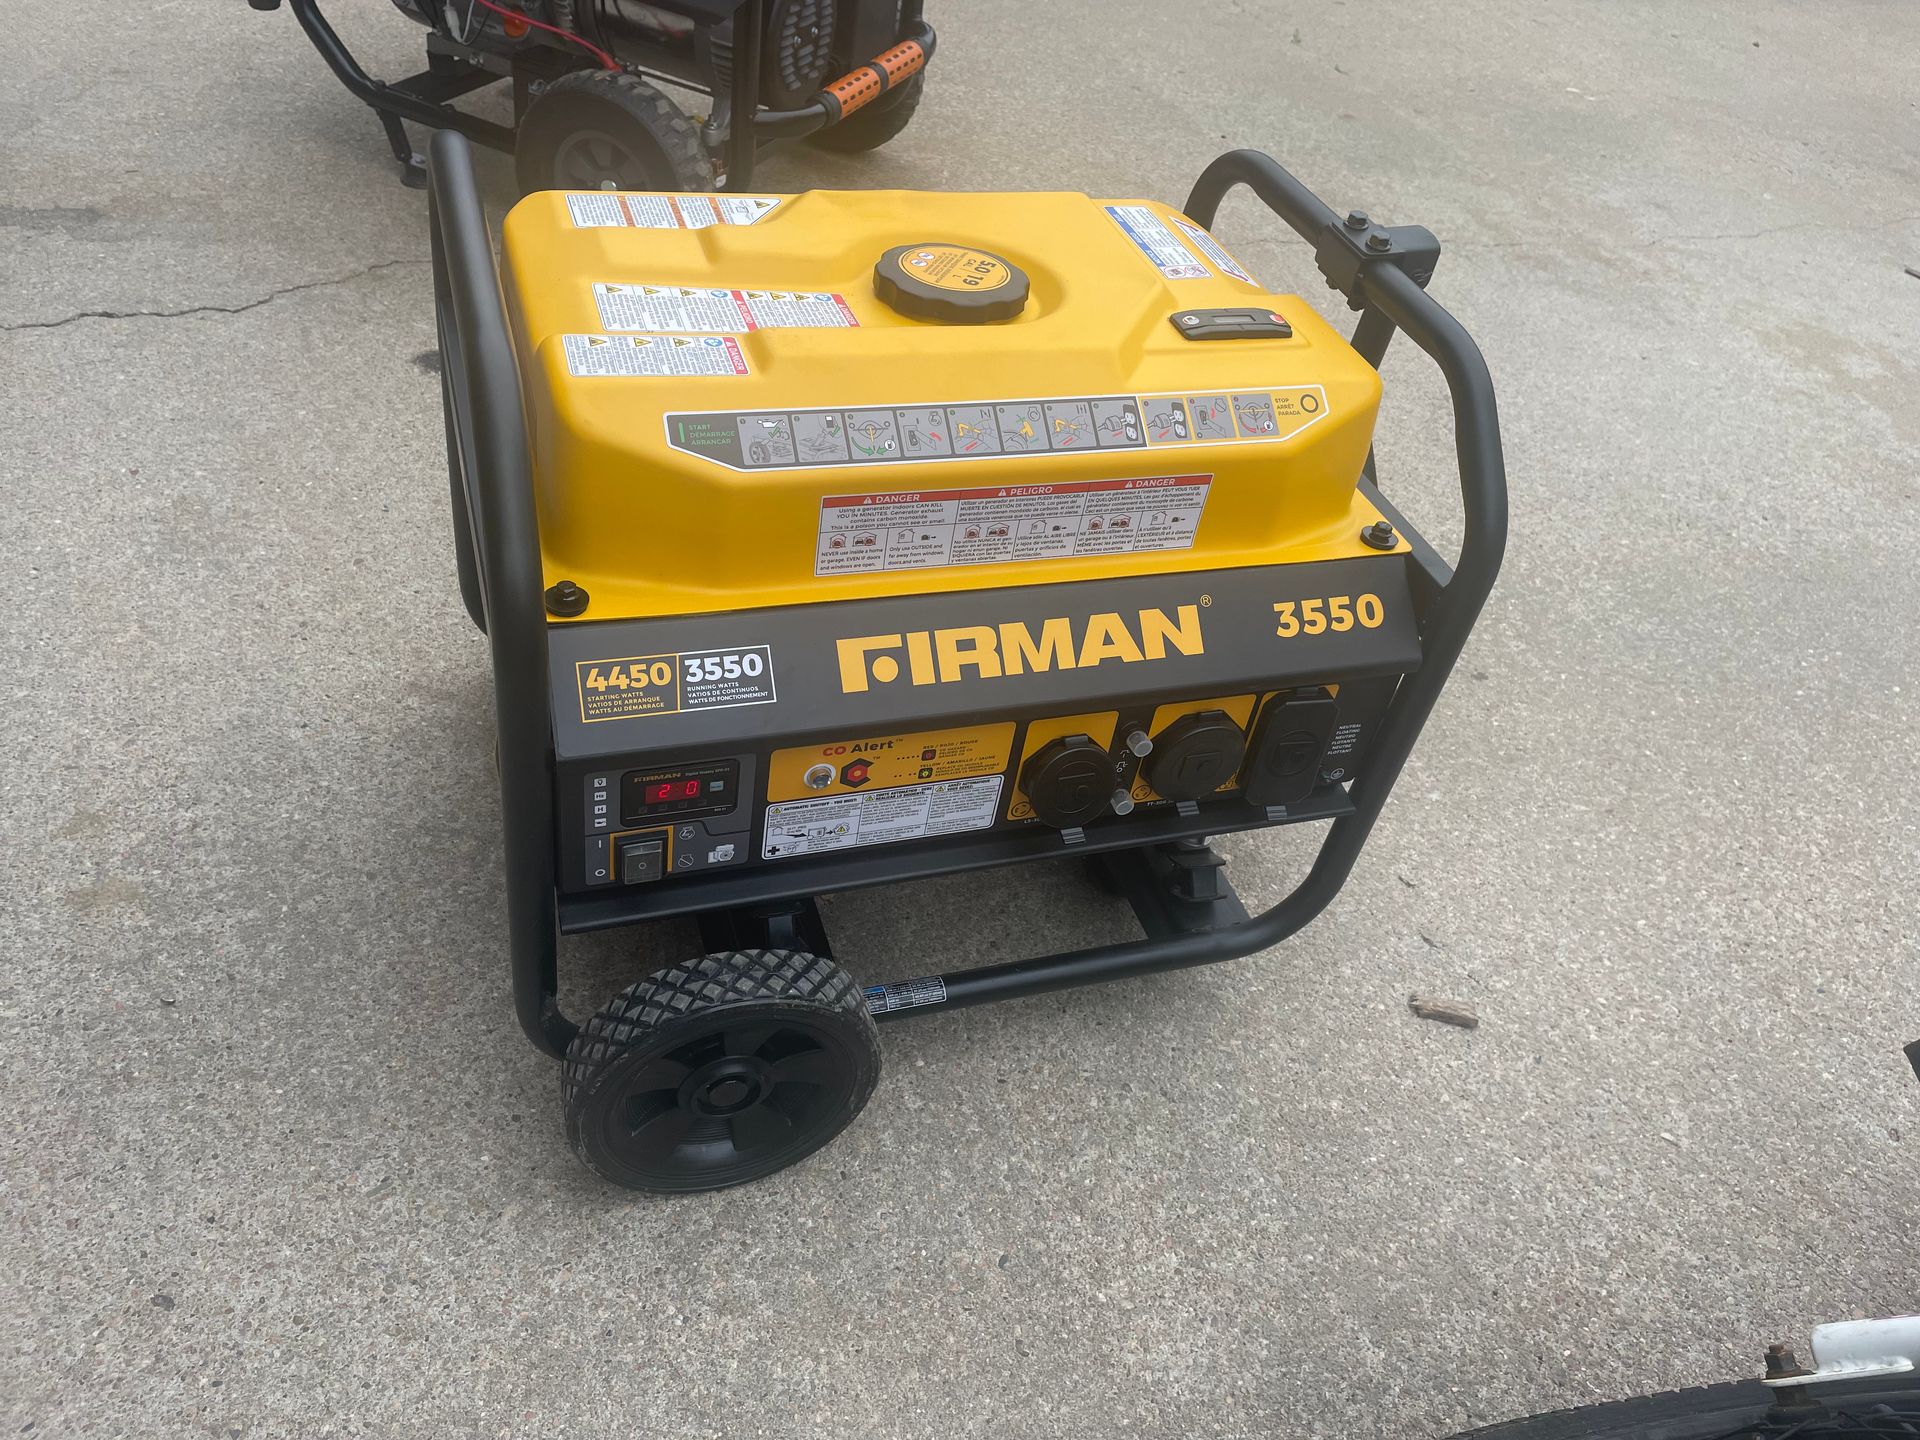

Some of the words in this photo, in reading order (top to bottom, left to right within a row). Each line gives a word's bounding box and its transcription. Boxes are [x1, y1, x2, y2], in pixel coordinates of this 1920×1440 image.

[962, 274, 984, 286] 19
[1136, 479, 1175, 487] DANGER
[1010, 486, 1052, 495] PELIGRO
[876, 494, 920, 503] DANGER
[1274, 594, 1384, 638] 3550
[836, 604, 1204, 694] FIRMAN
[684, 654, 763, 682] 3550
[586, 662, 672, 692] 4450
[722, 686, 759, 694] CONTINUOS
[624, 696, 660, 705] ARRANQUE
[717, 691, 769, 702] FONCTIONNEMENT
[823, 746, 846, 756] CO
[851, 740, 894, 753] Alert
[634, 773, 681, 782] FIRMAN
[658, 783, 671, 800] 2
[686, 780, 698, 795] 0
